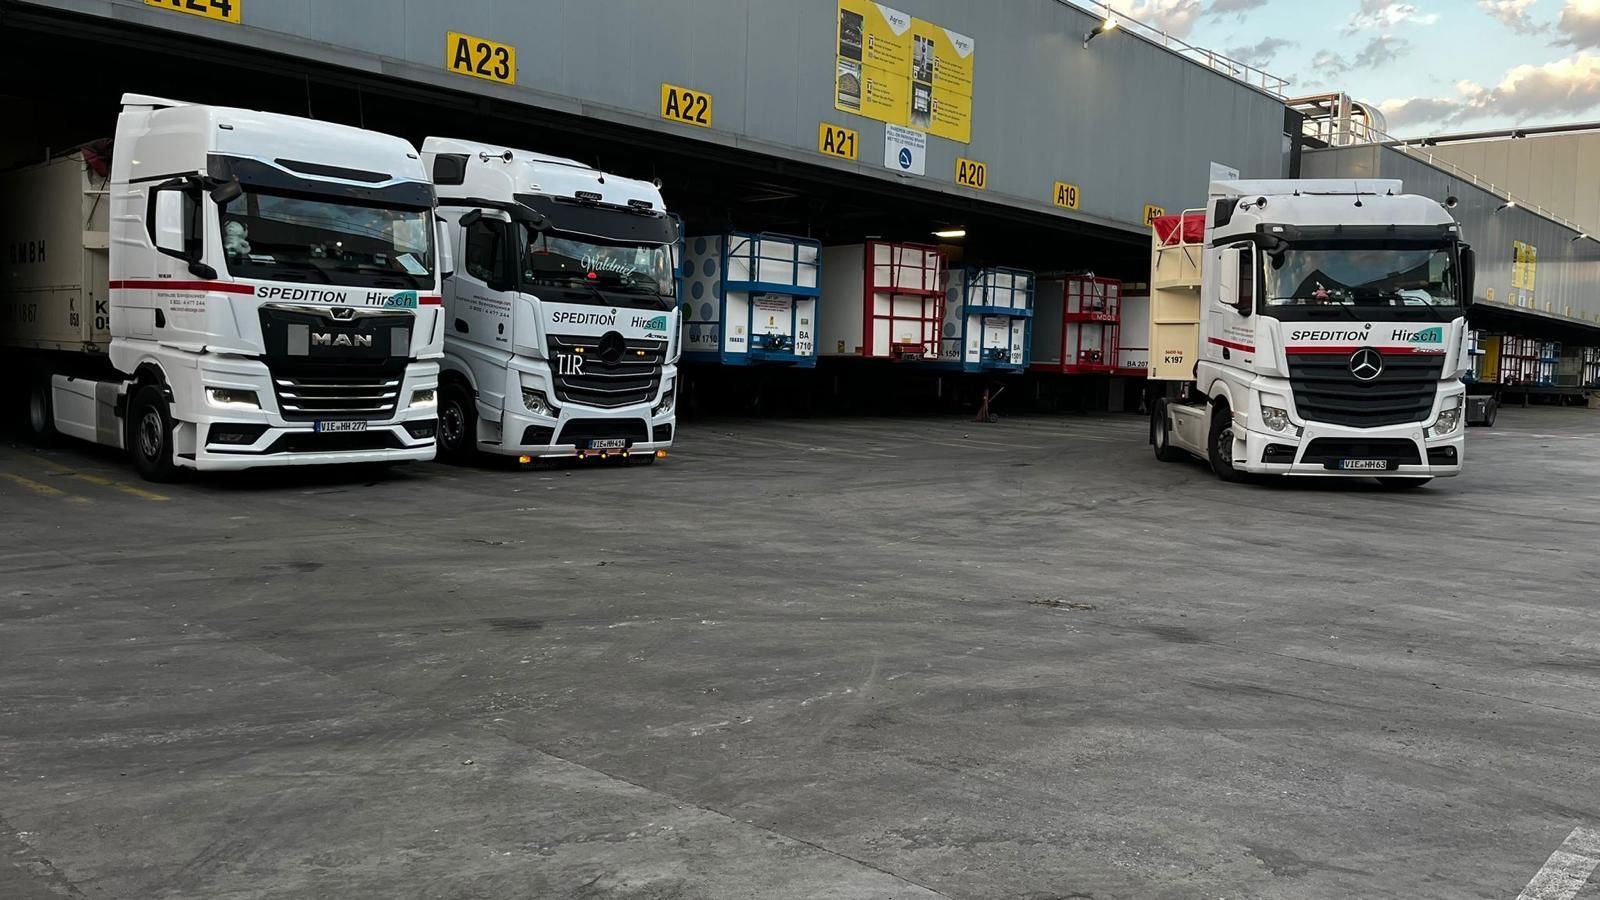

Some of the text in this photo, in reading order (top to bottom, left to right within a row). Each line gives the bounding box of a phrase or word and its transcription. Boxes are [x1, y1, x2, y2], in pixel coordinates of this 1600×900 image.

[454, 38, 509, 79] A23
[666, 89, 707, 124] A22
[824, 128, 854, 157] A21
[959, 161, 984, 187] A20
[1058, 185, 1076, 207] A19
[257, 287, 412, 307] SPEDITION Hirsch
[552, 311, 664, 329] SPEDITION Hirsch
[311, 332, 372, 347] MAN
[799, 331, 809, 339] BA
[1291, 329, 1437, 342] SPEDITION Hirsch
[797, 342, 812, 351] 1710
[945, 350, 960, 358] 1501
[321, 423, 335, 431] VIE
[1345, 460, 1360, 468] VIE
